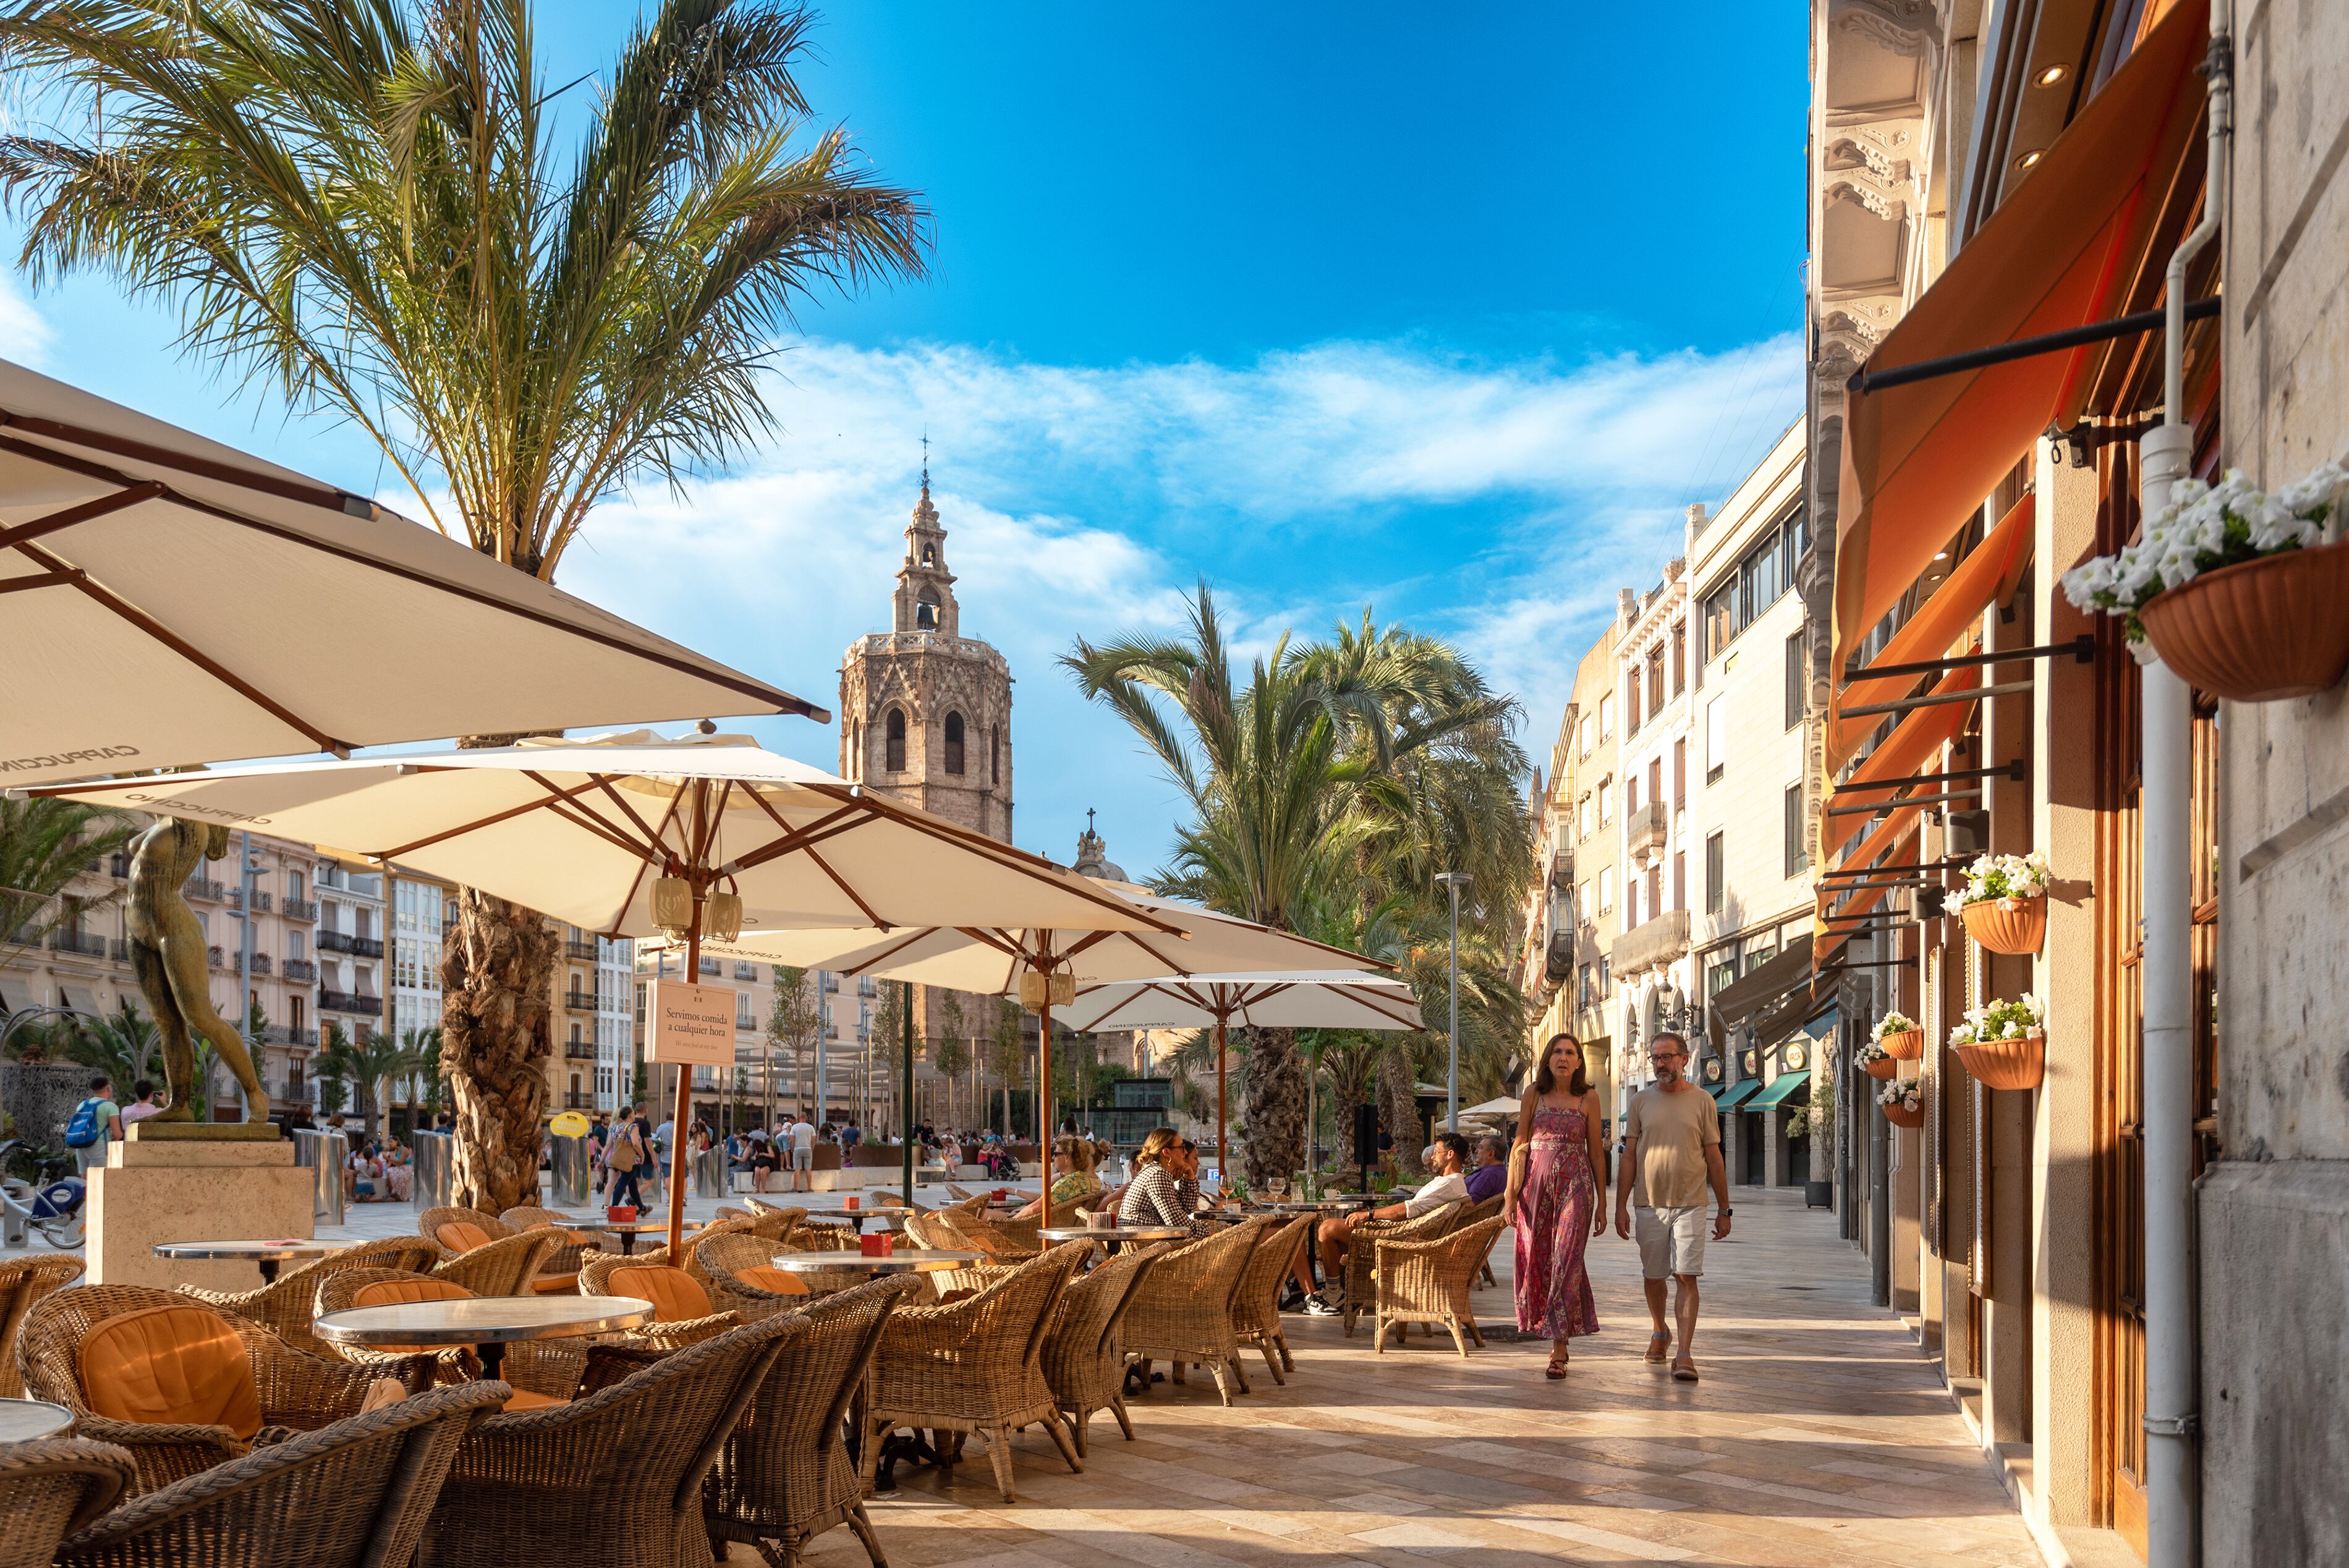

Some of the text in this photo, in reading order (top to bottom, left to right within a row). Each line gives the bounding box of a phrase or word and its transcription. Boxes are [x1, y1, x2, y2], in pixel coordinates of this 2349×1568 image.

[666, 1007, 728, 1025] Servimos comida
[674, 1022, 708, 1036] cualquier
[709, 1025, 726, 1037] hora
[1788, 1051, 1801, 1061] VALOR
